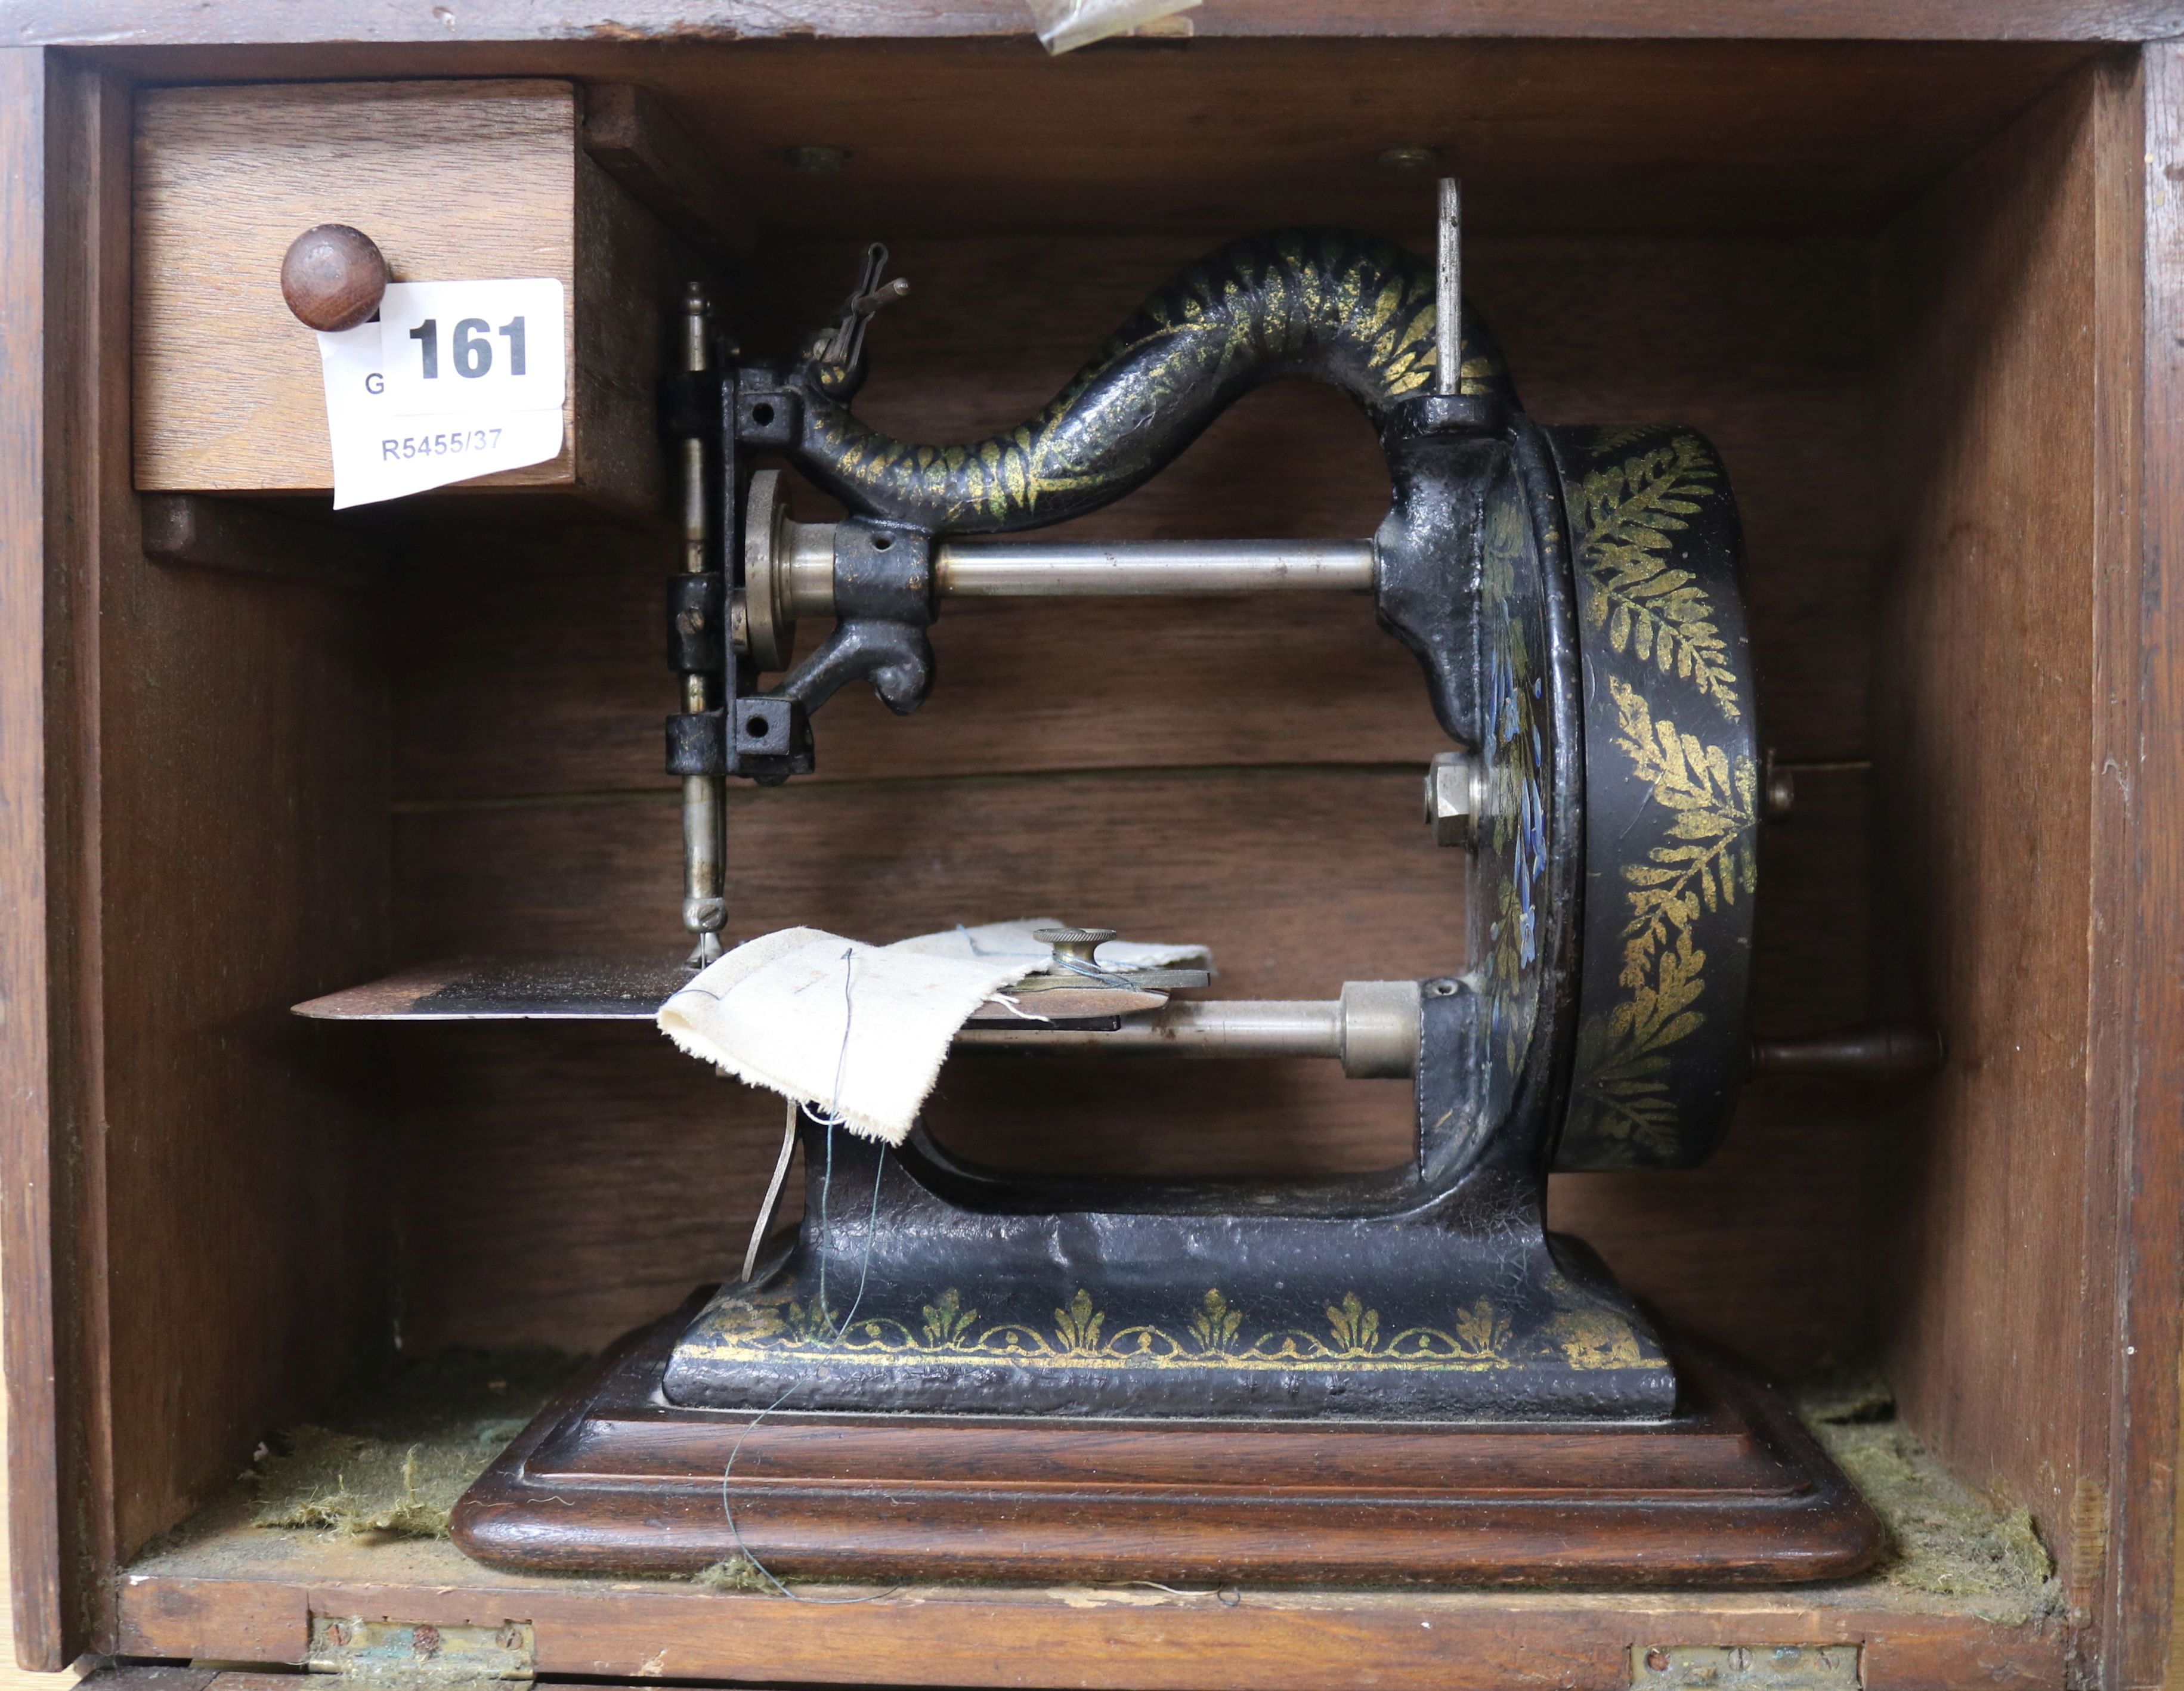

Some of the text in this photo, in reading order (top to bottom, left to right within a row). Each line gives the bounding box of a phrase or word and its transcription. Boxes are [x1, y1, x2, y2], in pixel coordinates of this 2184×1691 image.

[410, 316, 526, 379] 161
[365, 372, 385, 395] G
[382, 428, 503, 461] R5455/37
